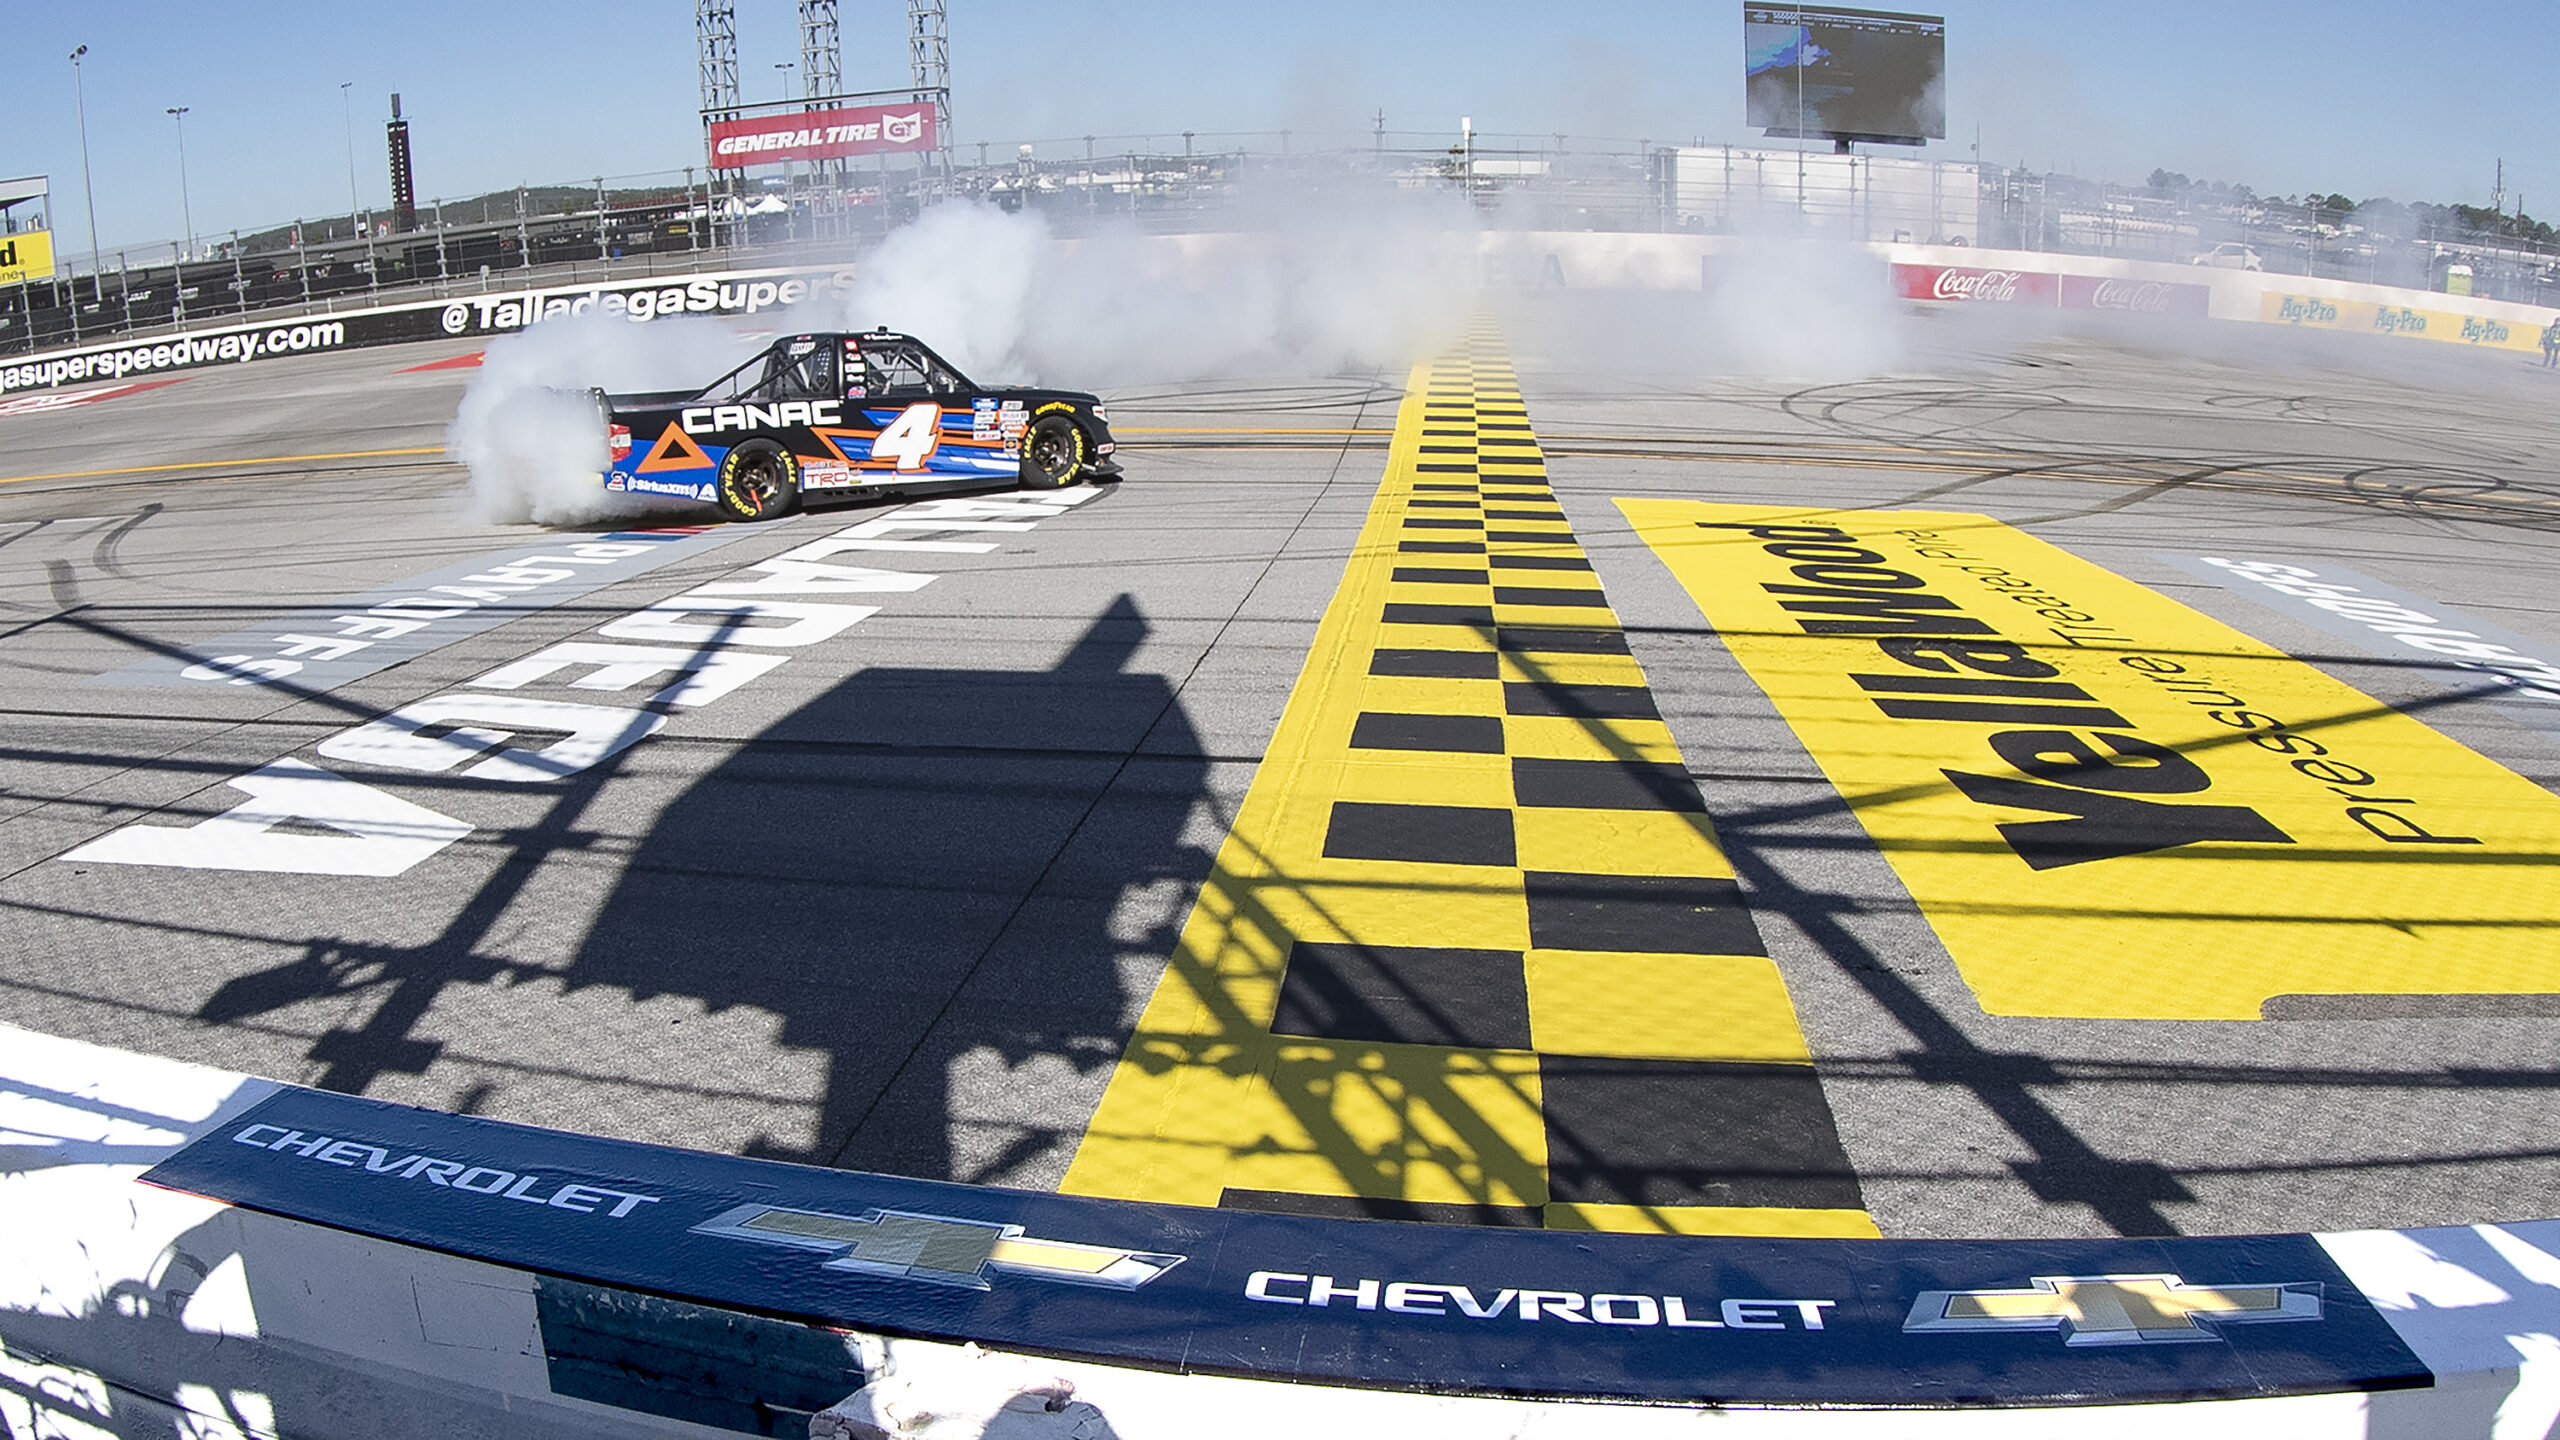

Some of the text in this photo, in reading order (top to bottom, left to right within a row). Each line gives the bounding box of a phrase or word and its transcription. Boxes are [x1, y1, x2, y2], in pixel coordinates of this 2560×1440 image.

[717, 123, 881, 155] GENERAL TIRE
[1933, 268, 2021, 301] Coca-Cola
[0, 321, 344, 396] asuperspeedway.com
[681, 400, 842, 434] CANAC
[870, 402, 941, 470] 4
[1035, 401, 1076, 416] GOODYEAR
[779, 450, 796, 484] EAGLE
[1058, 428, 1083, 485] GOODYEAR
[180, 542, 659, 686] PLAYOFFS
[1695, 521, 2297, 871] YellaWood
[1894, 529, 2484, 845] Pressure Treated Pine
[232, 1122, 661, 1219] CHEVROLET
[1245, 1270, 1836, 1330] CHEVROLET
